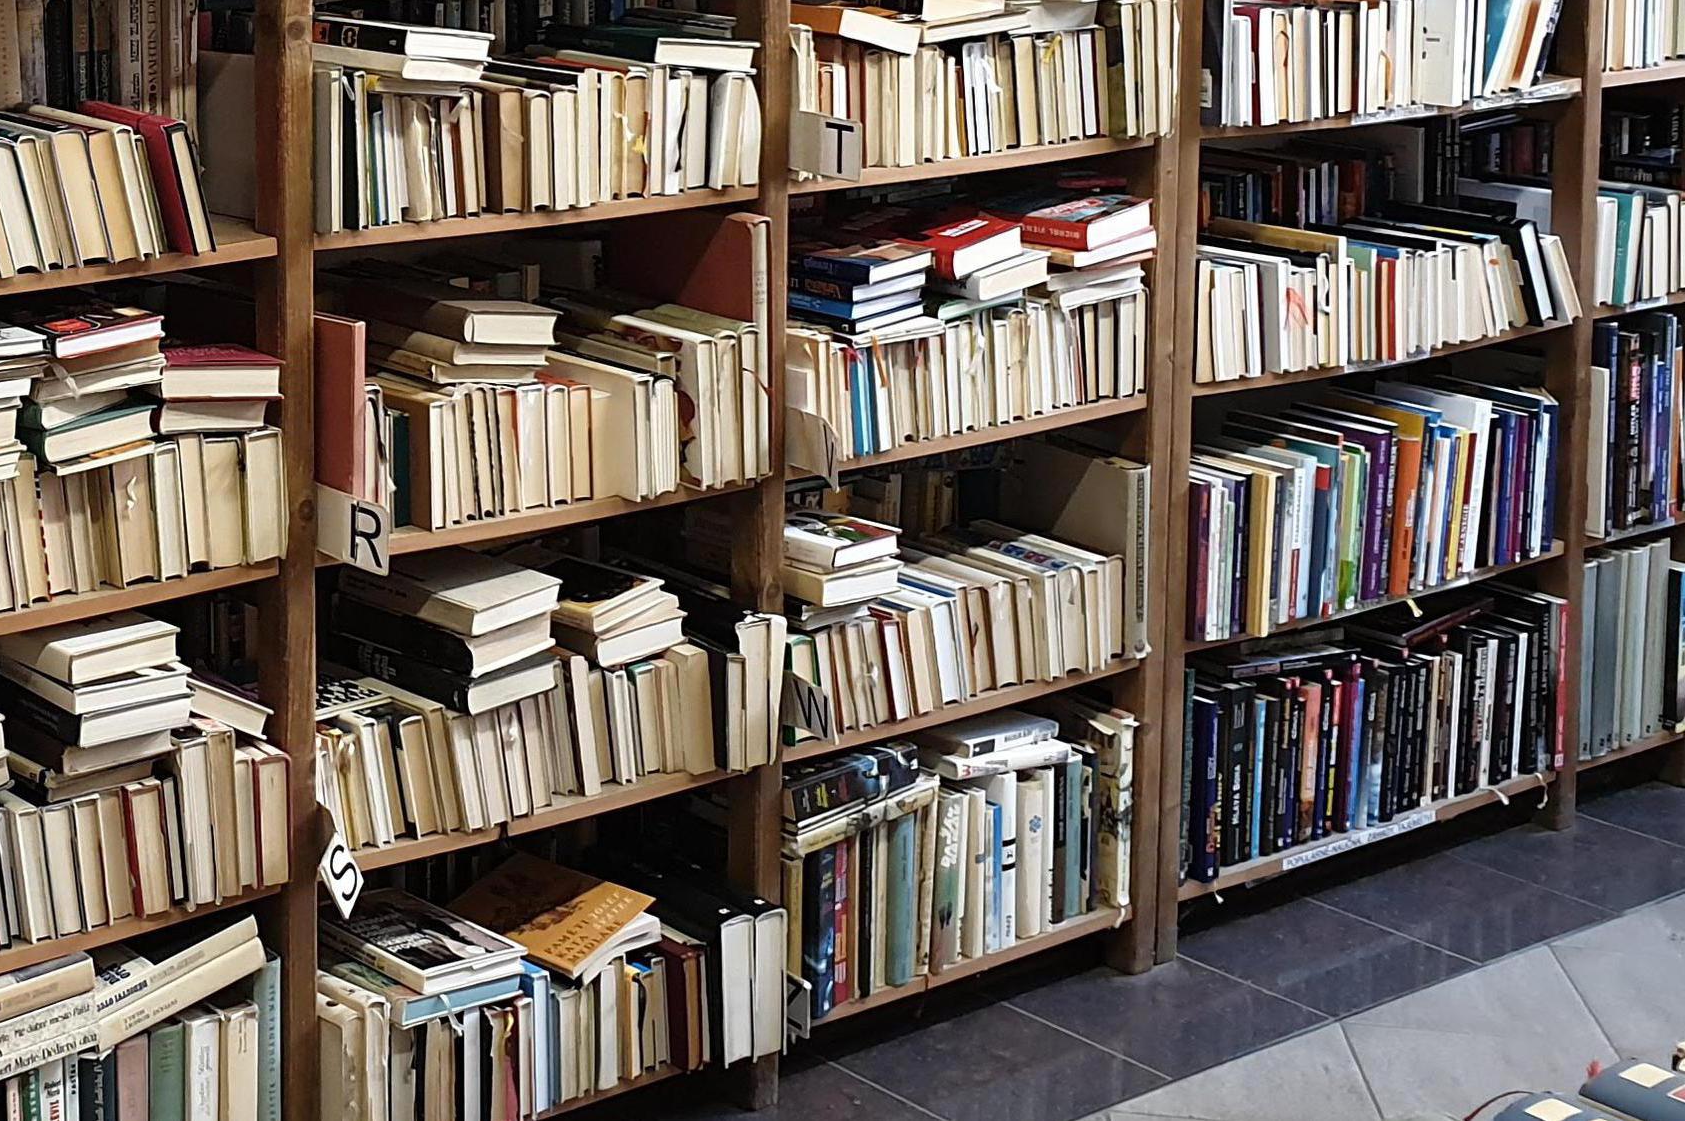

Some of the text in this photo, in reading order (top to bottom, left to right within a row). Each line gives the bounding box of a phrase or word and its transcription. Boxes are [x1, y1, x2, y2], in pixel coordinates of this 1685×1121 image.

[823, 120, 856, 175] T
[350, 504, 382, 569] R
[799, 691, 830, 741] W
[328, 843, 358, 902] S
